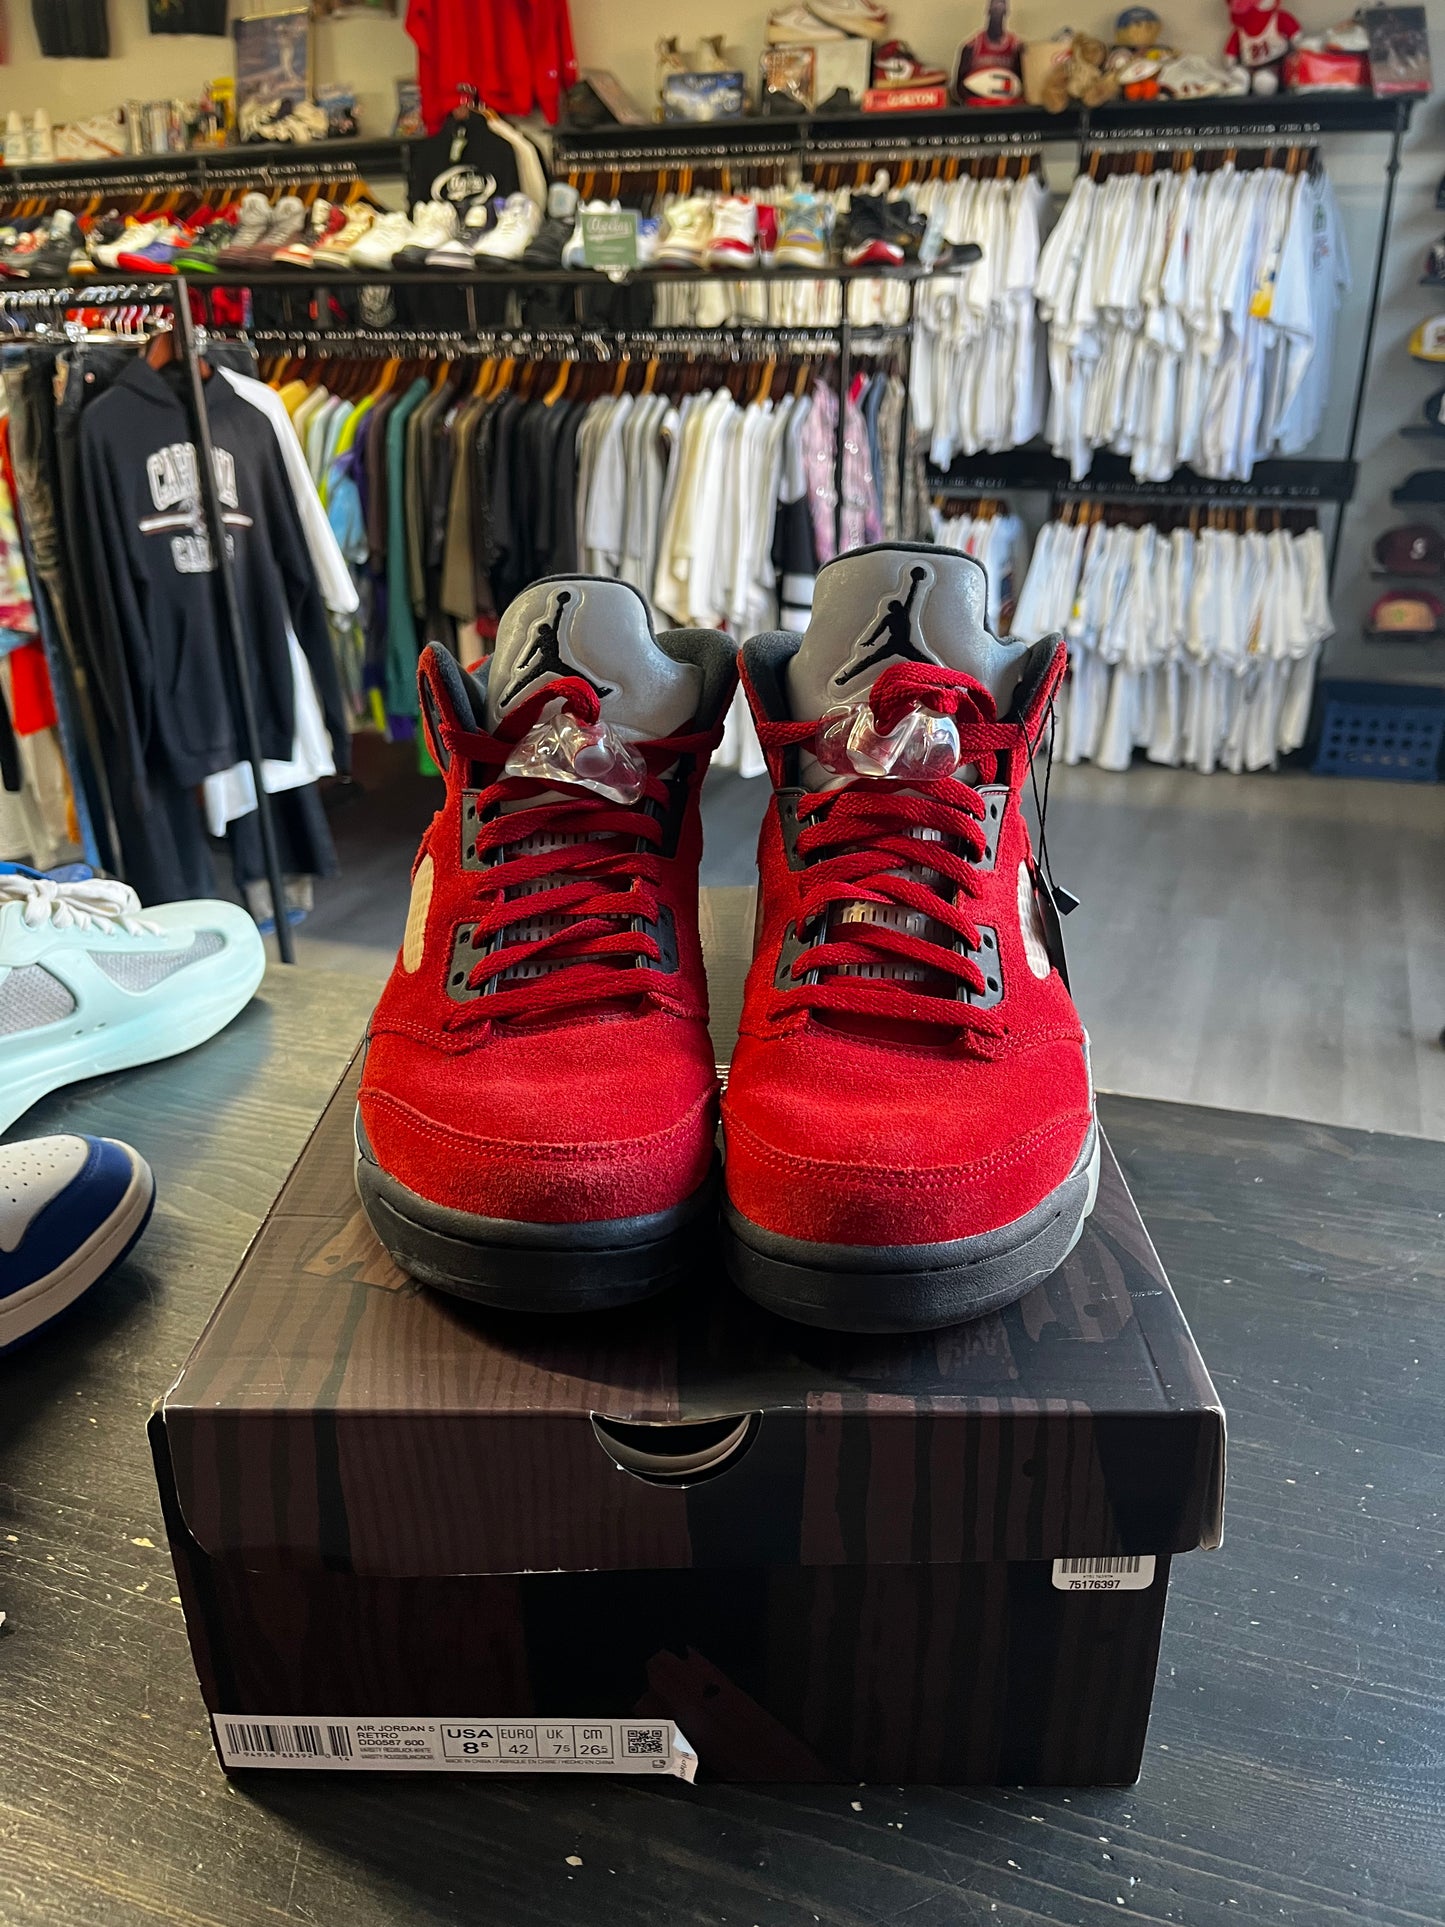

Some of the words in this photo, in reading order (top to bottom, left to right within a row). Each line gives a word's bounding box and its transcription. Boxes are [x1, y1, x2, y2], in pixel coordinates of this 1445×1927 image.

[1069, 1580, 1121, 1589] 75176397
[447, 1728, 494, 1739] USA
[501, 1728, 534, 1740] EURO
[546, 1729, 564, 1740] UK
[508, 1744, 529, 1755] 42
